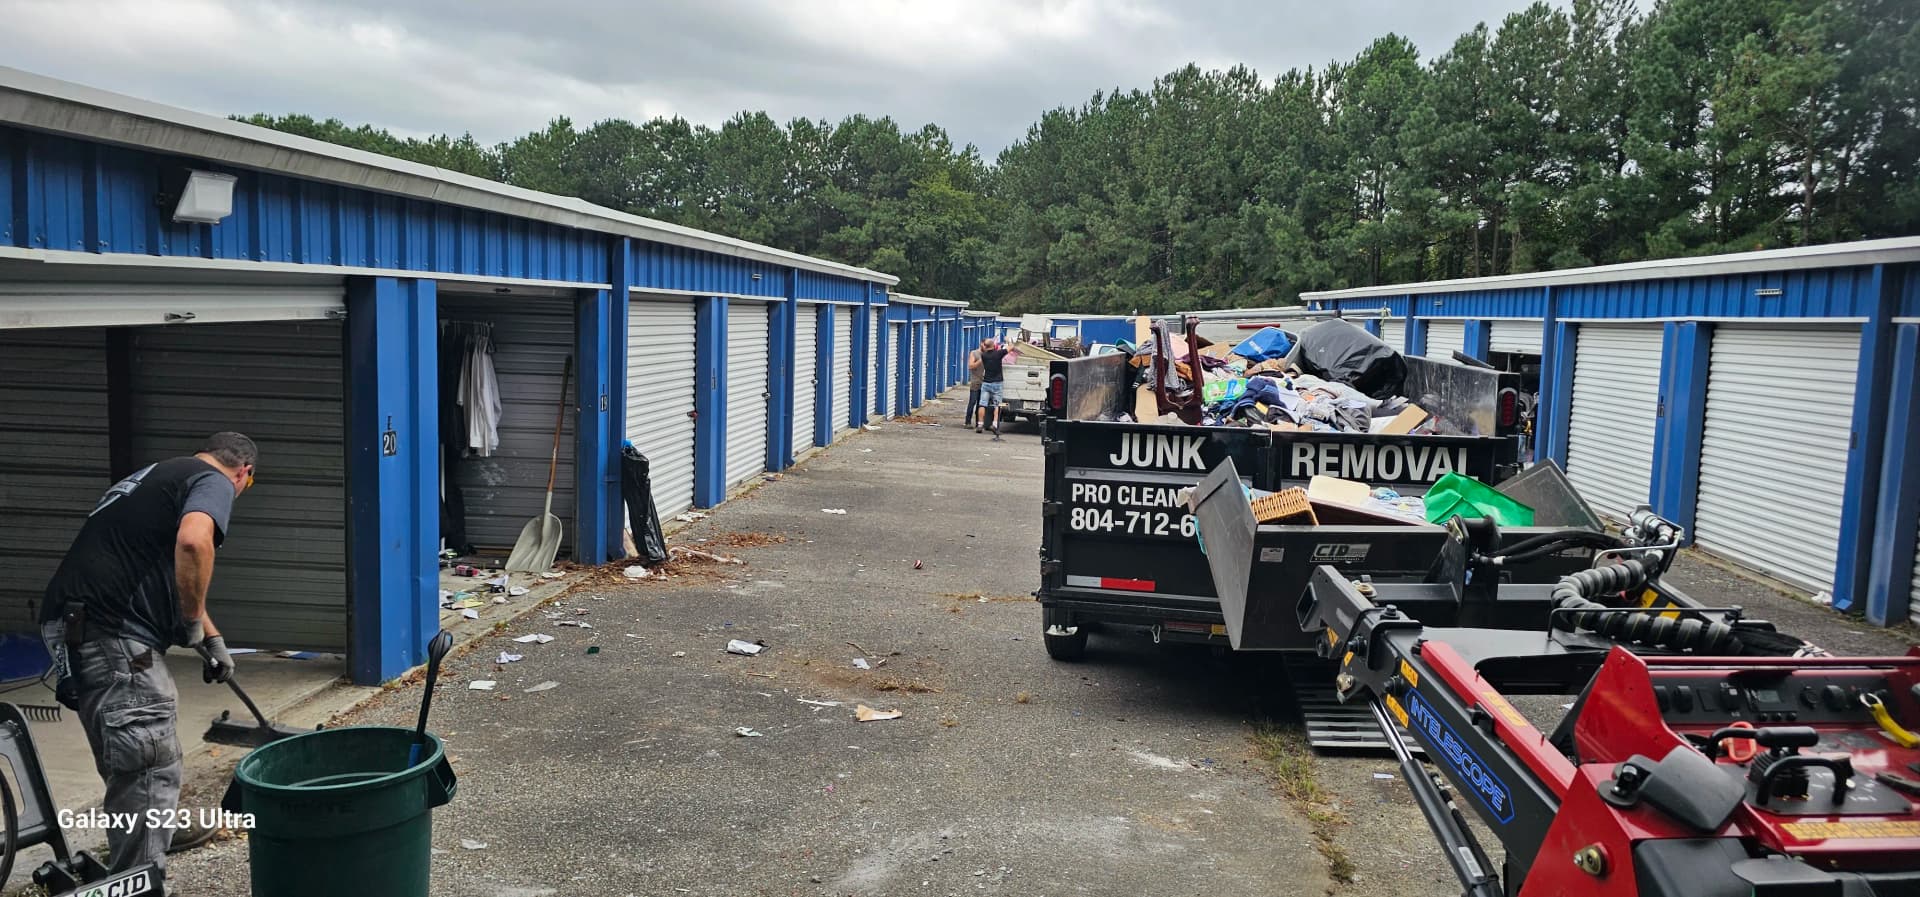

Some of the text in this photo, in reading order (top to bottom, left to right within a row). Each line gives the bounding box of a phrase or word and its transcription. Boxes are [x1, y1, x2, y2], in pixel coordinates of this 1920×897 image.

[383, 433, 396, 455] 20
[1109, 432, 1479, 482] JUNK REMOVAL
[1071, 483, 1112, 504] PRO
[1070, 507, 1196, 538] 804-712-6
[1315, 544, 1350, 557] CID
[1410, 695, 1506, 812] INTELESCOPE
[107, 873, 146, 897] CID
